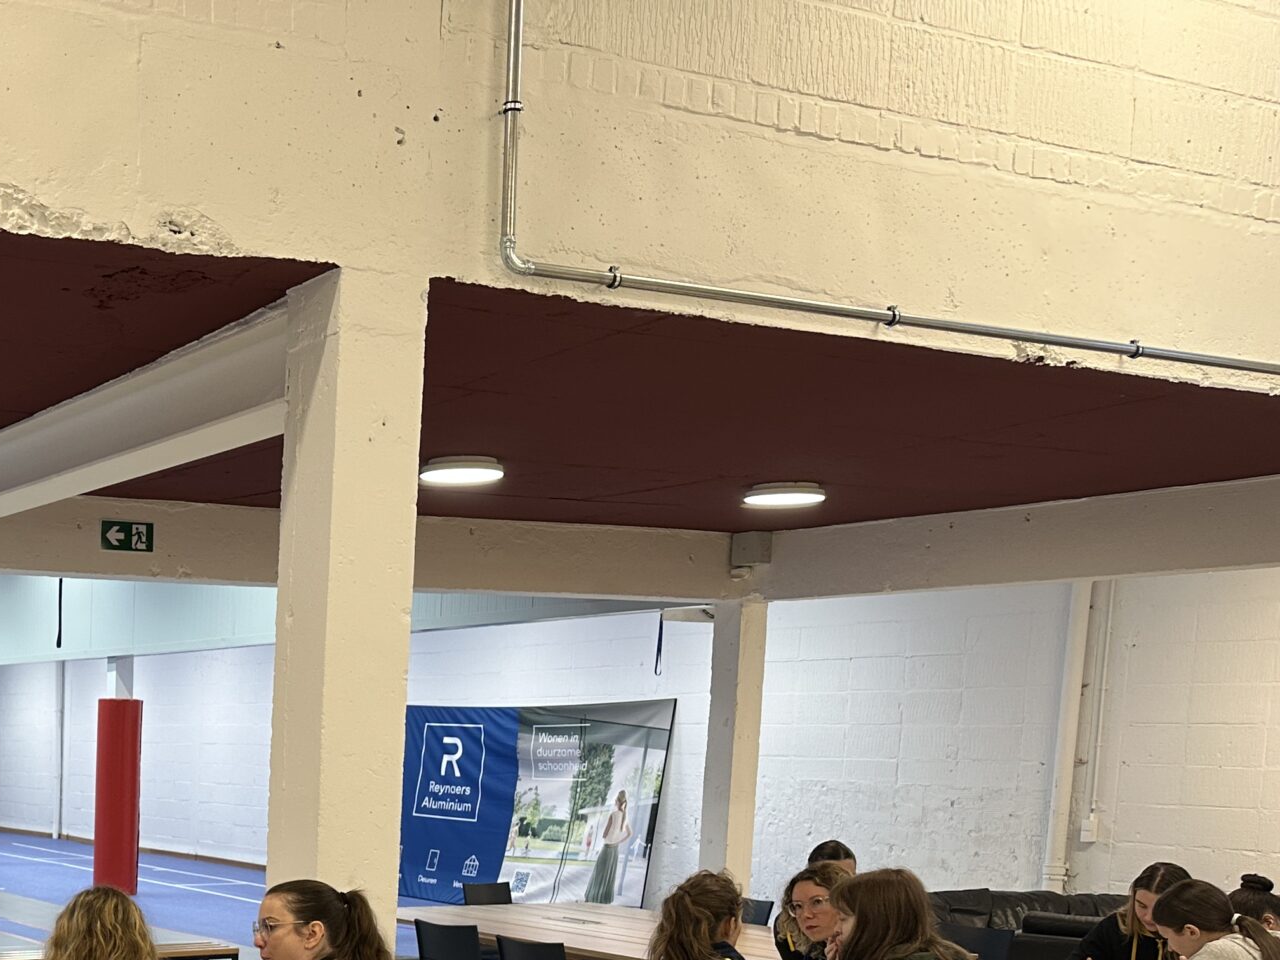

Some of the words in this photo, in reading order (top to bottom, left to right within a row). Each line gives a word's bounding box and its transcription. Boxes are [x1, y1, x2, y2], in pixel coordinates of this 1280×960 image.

[538, 732, 568, 743] Wonen
[570, 731, 579, 742] in
[440, 736, 463, 777] R
[536, 746, 581, 757] duurzame
[429, 781, 471, 796] Reynaers
[421, 796, 472, 812] Aluminium
